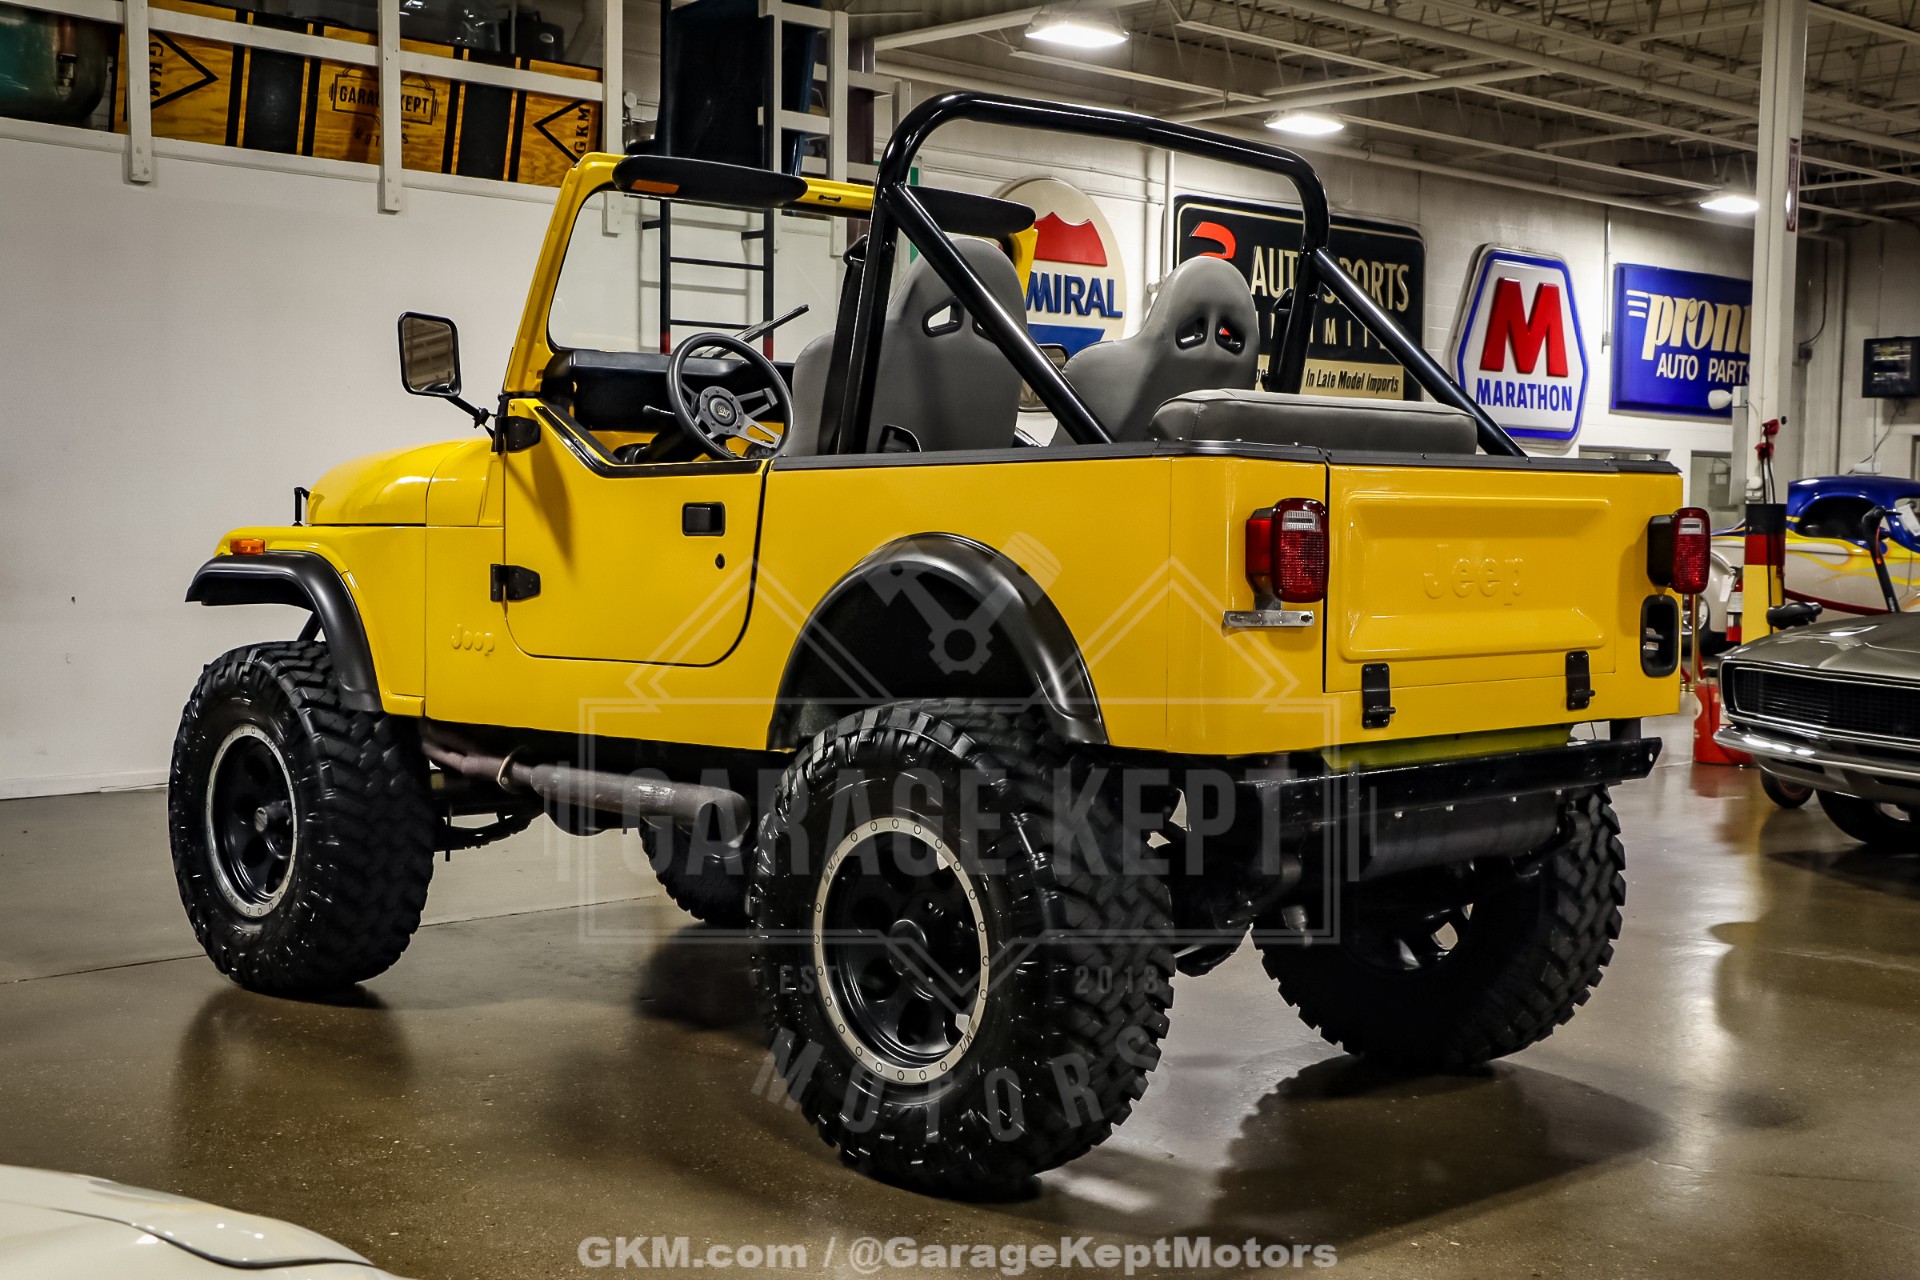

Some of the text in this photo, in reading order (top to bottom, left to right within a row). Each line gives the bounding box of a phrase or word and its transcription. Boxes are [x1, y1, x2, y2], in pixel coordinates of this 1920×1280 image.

[339, 85, 380, 108] GARA
[574, 106, 590, 154] GKM
[1026, 269, 1123, 319] MIRAL
[1479, 276, 1569, 378] M
[1306, 368, 1400, 395] In Late Model Imports
[1655, 352, 1699, 381] AUTO
[1475, 377, 1573, 412] MARATHON
[1423, 543, 1524, 606] Jeep
